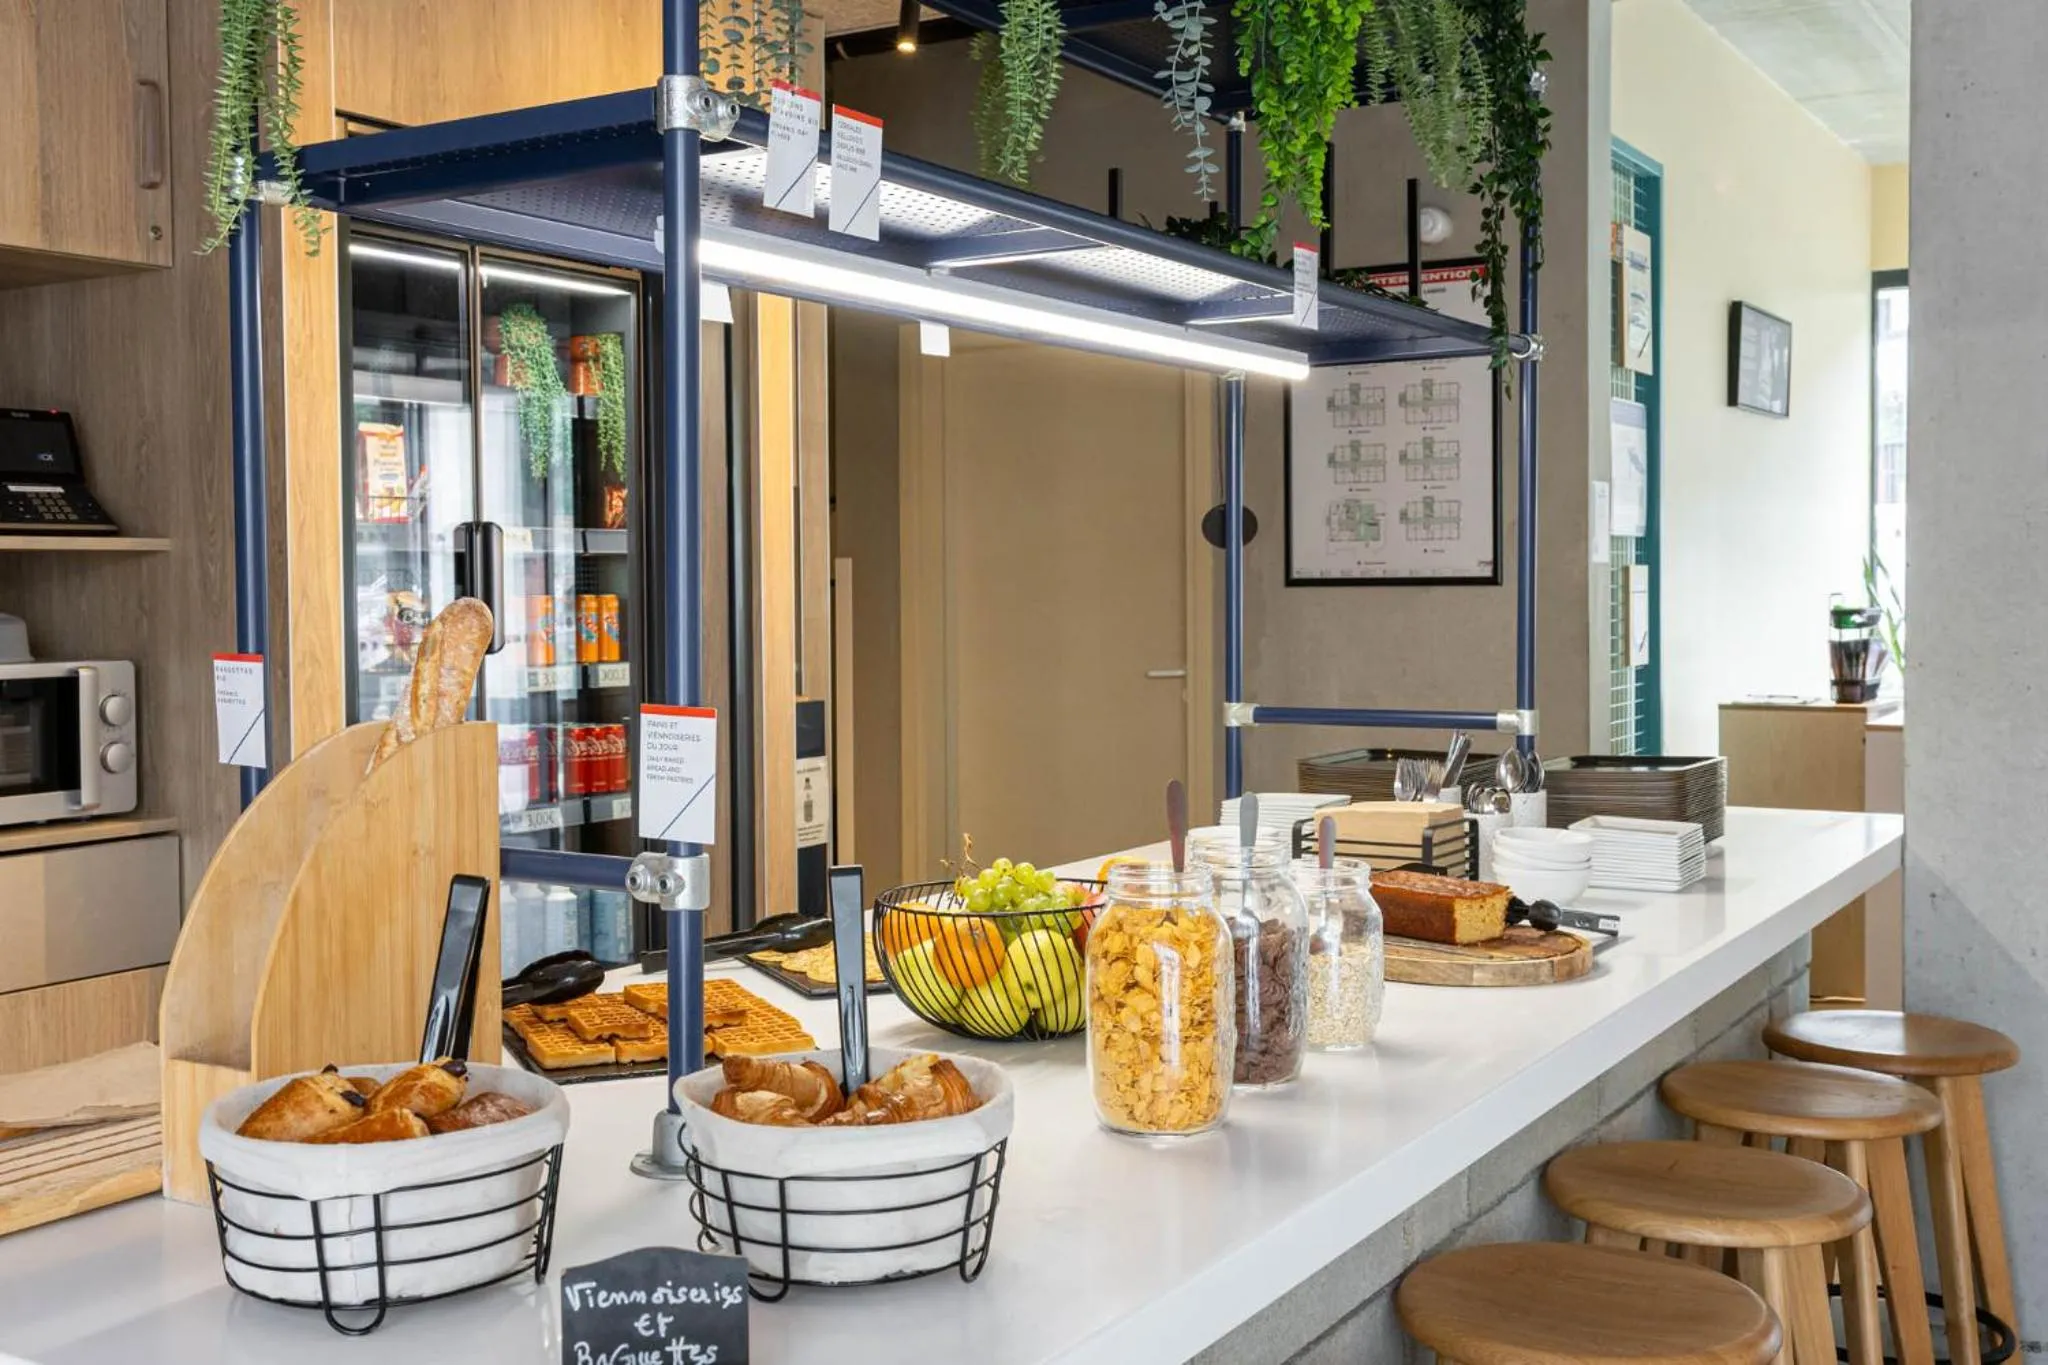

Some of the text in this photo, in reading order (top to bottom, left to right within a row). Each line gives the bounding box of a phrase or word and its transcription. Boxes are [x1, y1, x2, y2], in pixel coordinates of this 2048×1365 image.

[647, 720, 678, 730] PAINS ET
[647, 731, 701, 742] VIENNOISERIES
[647, 742, 679, 751] DU JOUR
